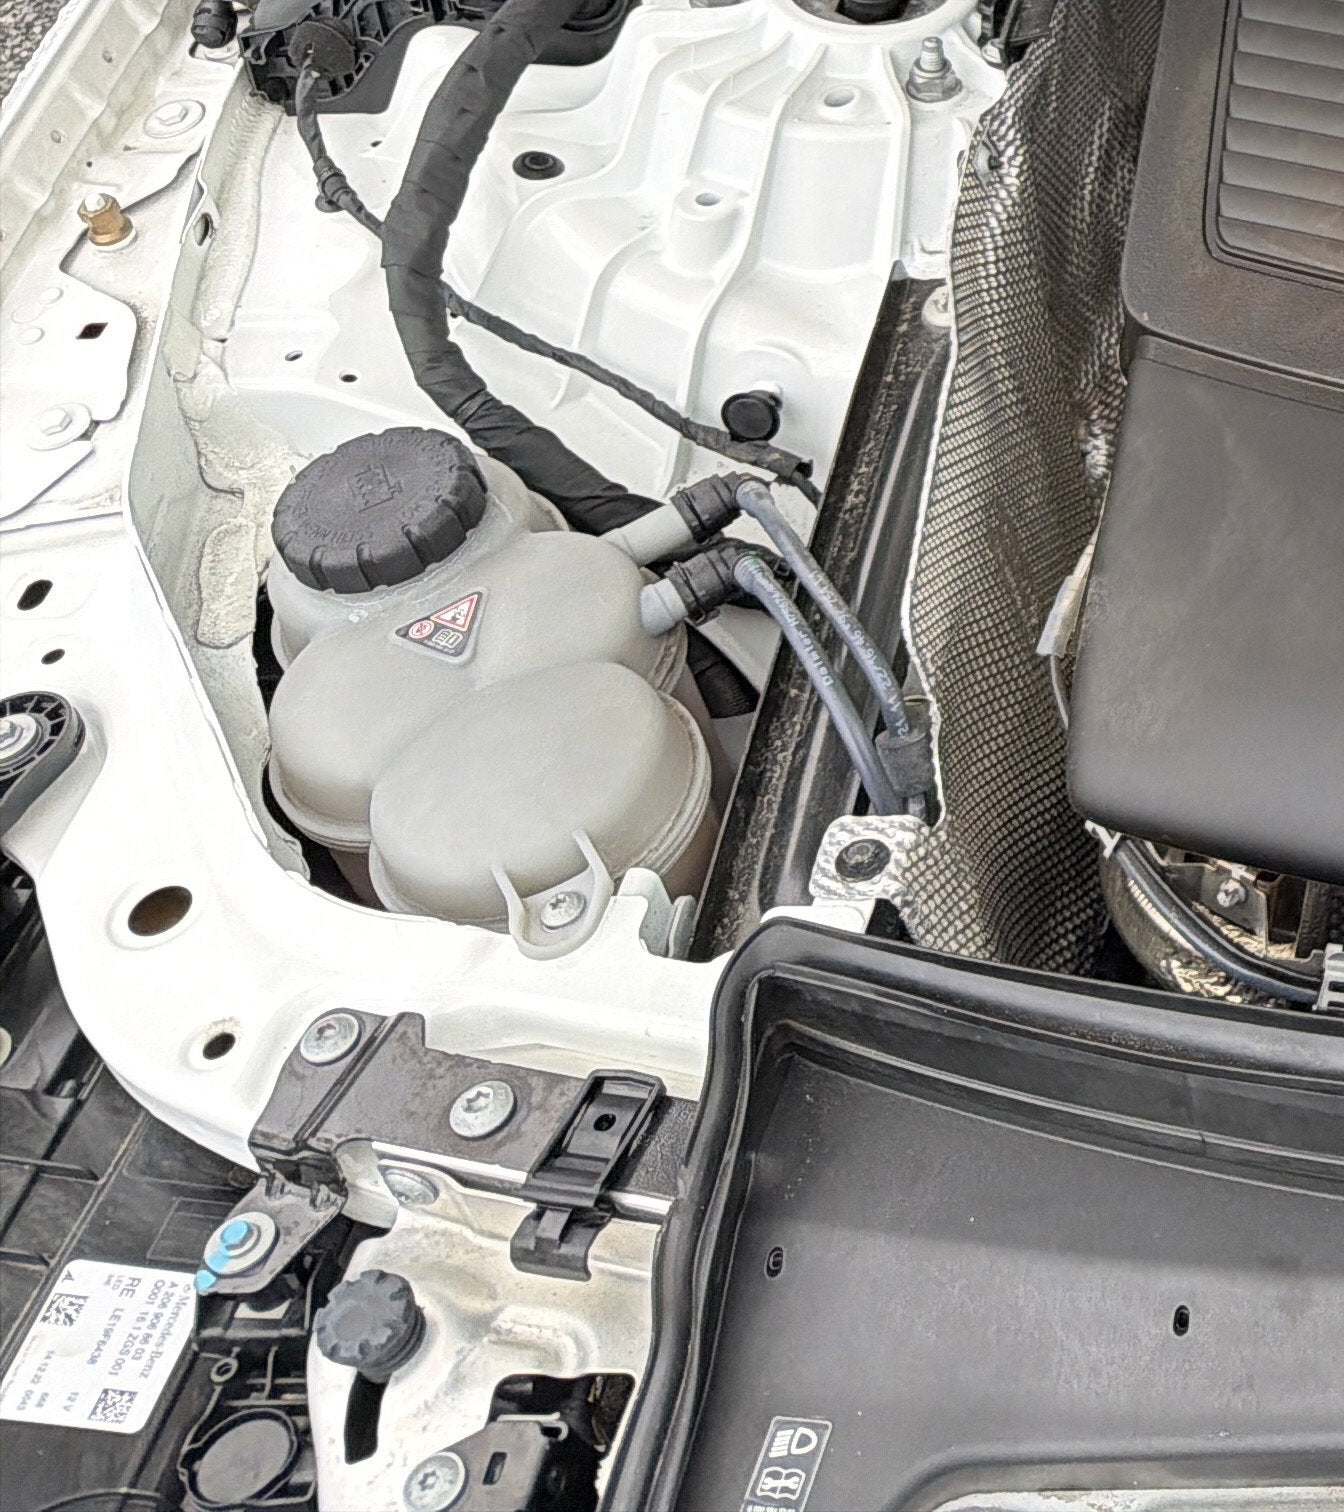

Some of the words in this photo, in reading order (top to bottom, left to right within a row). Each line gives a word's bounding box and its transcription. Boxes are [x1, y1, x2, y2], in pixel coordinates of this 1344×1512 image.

[118, 1277, 142, 1297] RE
[156, 1291, 174, 1309] 206
[131, 1310, 149, 1329] 16.1
[146, 1312, 164, 1330] 906
[118, 1333, 138, 1355] ZGS
[138, 1295, 189, 1379] Mercedes-Benz
[130, 1347, 146, 1360] 03
[107, 1357, 126, 1375] 001
